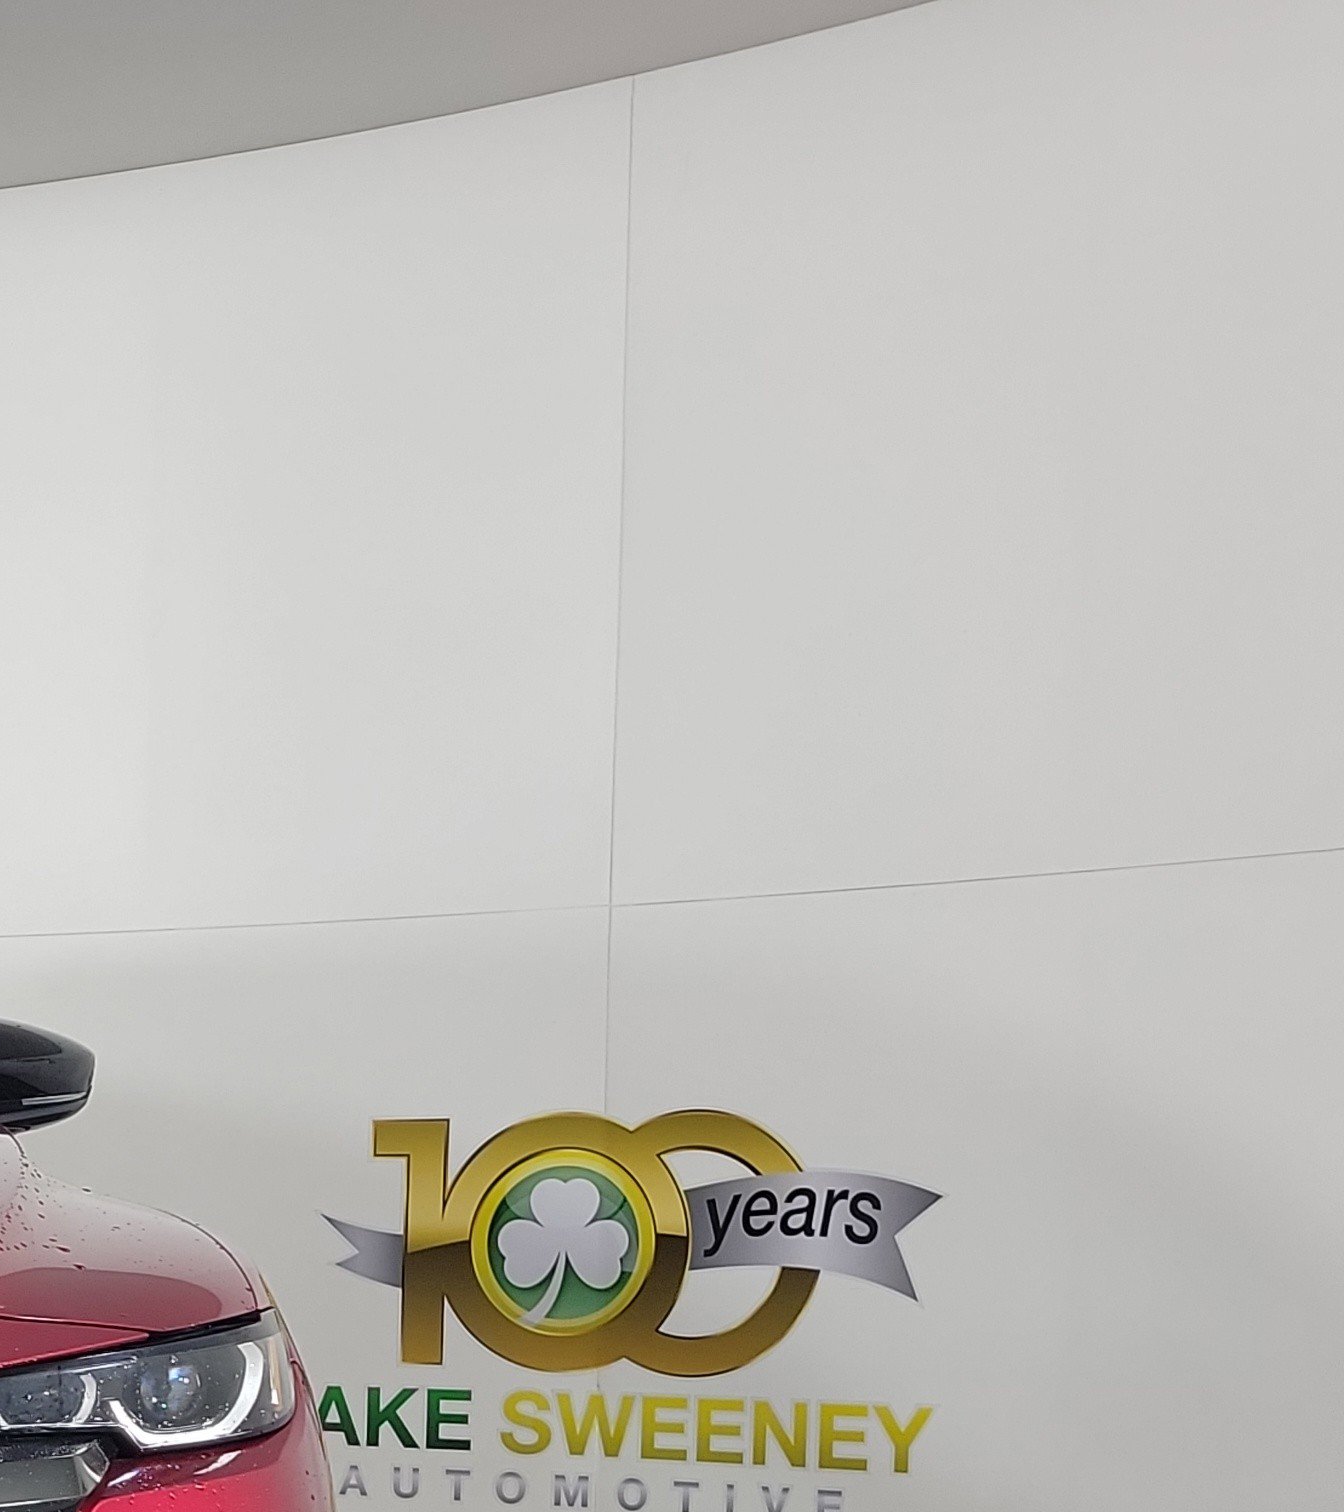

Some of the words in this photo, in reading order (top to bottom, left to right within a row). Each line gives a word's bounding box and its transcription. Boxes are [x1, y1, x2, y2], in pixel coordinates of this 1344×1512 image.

[373, 1109, 820, 1377] 100
[703, 1187, 882, 1258] years
[318, 1385, 472, 1451] AKE
[500, 1391, 933, 1473] SWEENEY
